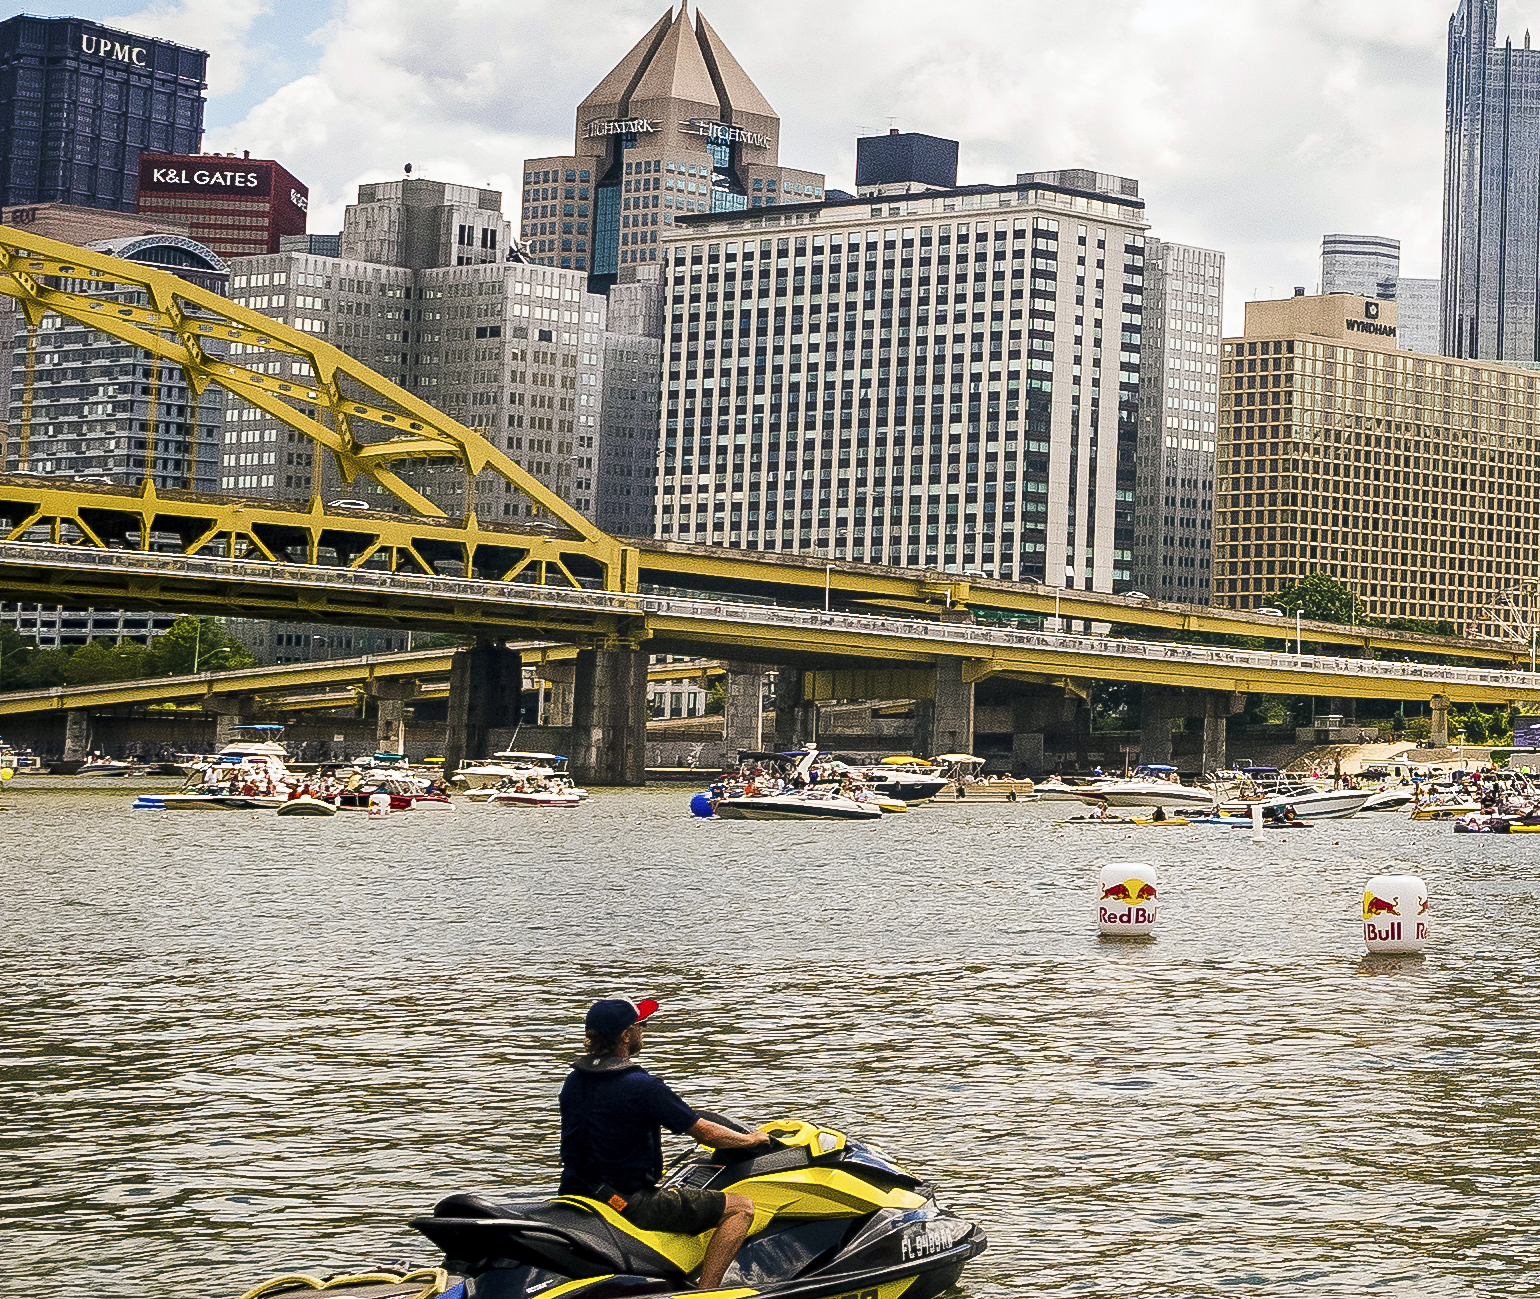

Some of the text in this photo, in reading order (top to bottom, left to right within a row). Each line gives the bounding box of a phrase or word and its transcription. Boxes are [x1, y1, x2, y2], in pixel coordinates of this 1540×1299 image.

[82, 34, 147, 66] UPMC
[153, 168, 258, 187] K&L GATES
[1346, 318, 1397, 337] WYNDHAM
[1099, 906, 1132, 924] Red
[1367, 921, 1402, 941] Bull
[902, 1236, 915, 1261] FL
